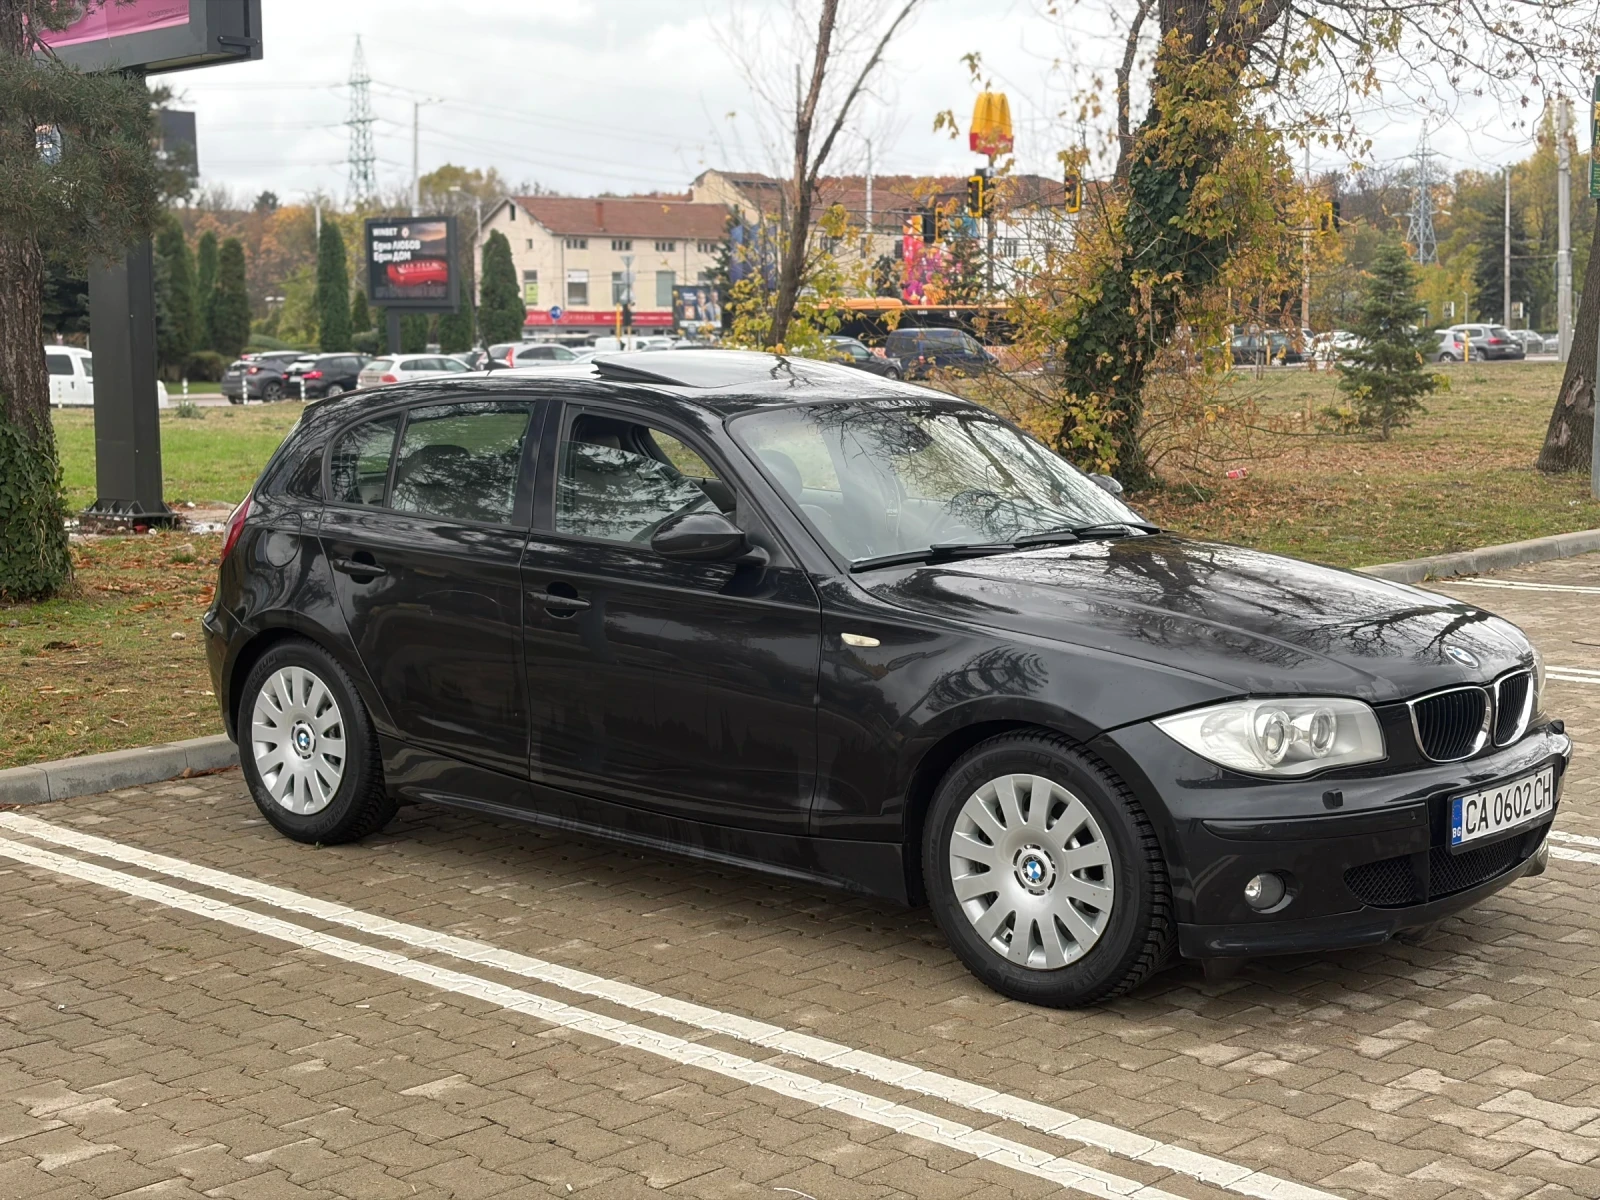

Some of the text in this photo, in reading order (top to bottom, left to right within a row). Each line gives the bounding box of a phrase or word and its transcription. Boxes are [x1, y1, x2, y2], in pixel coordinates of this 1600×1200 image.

[372, 227, 398, 237] WINBET
[1465, 773, 1552, 834] CA 0602 CH
[1452, 827, 1461, 838] BG
